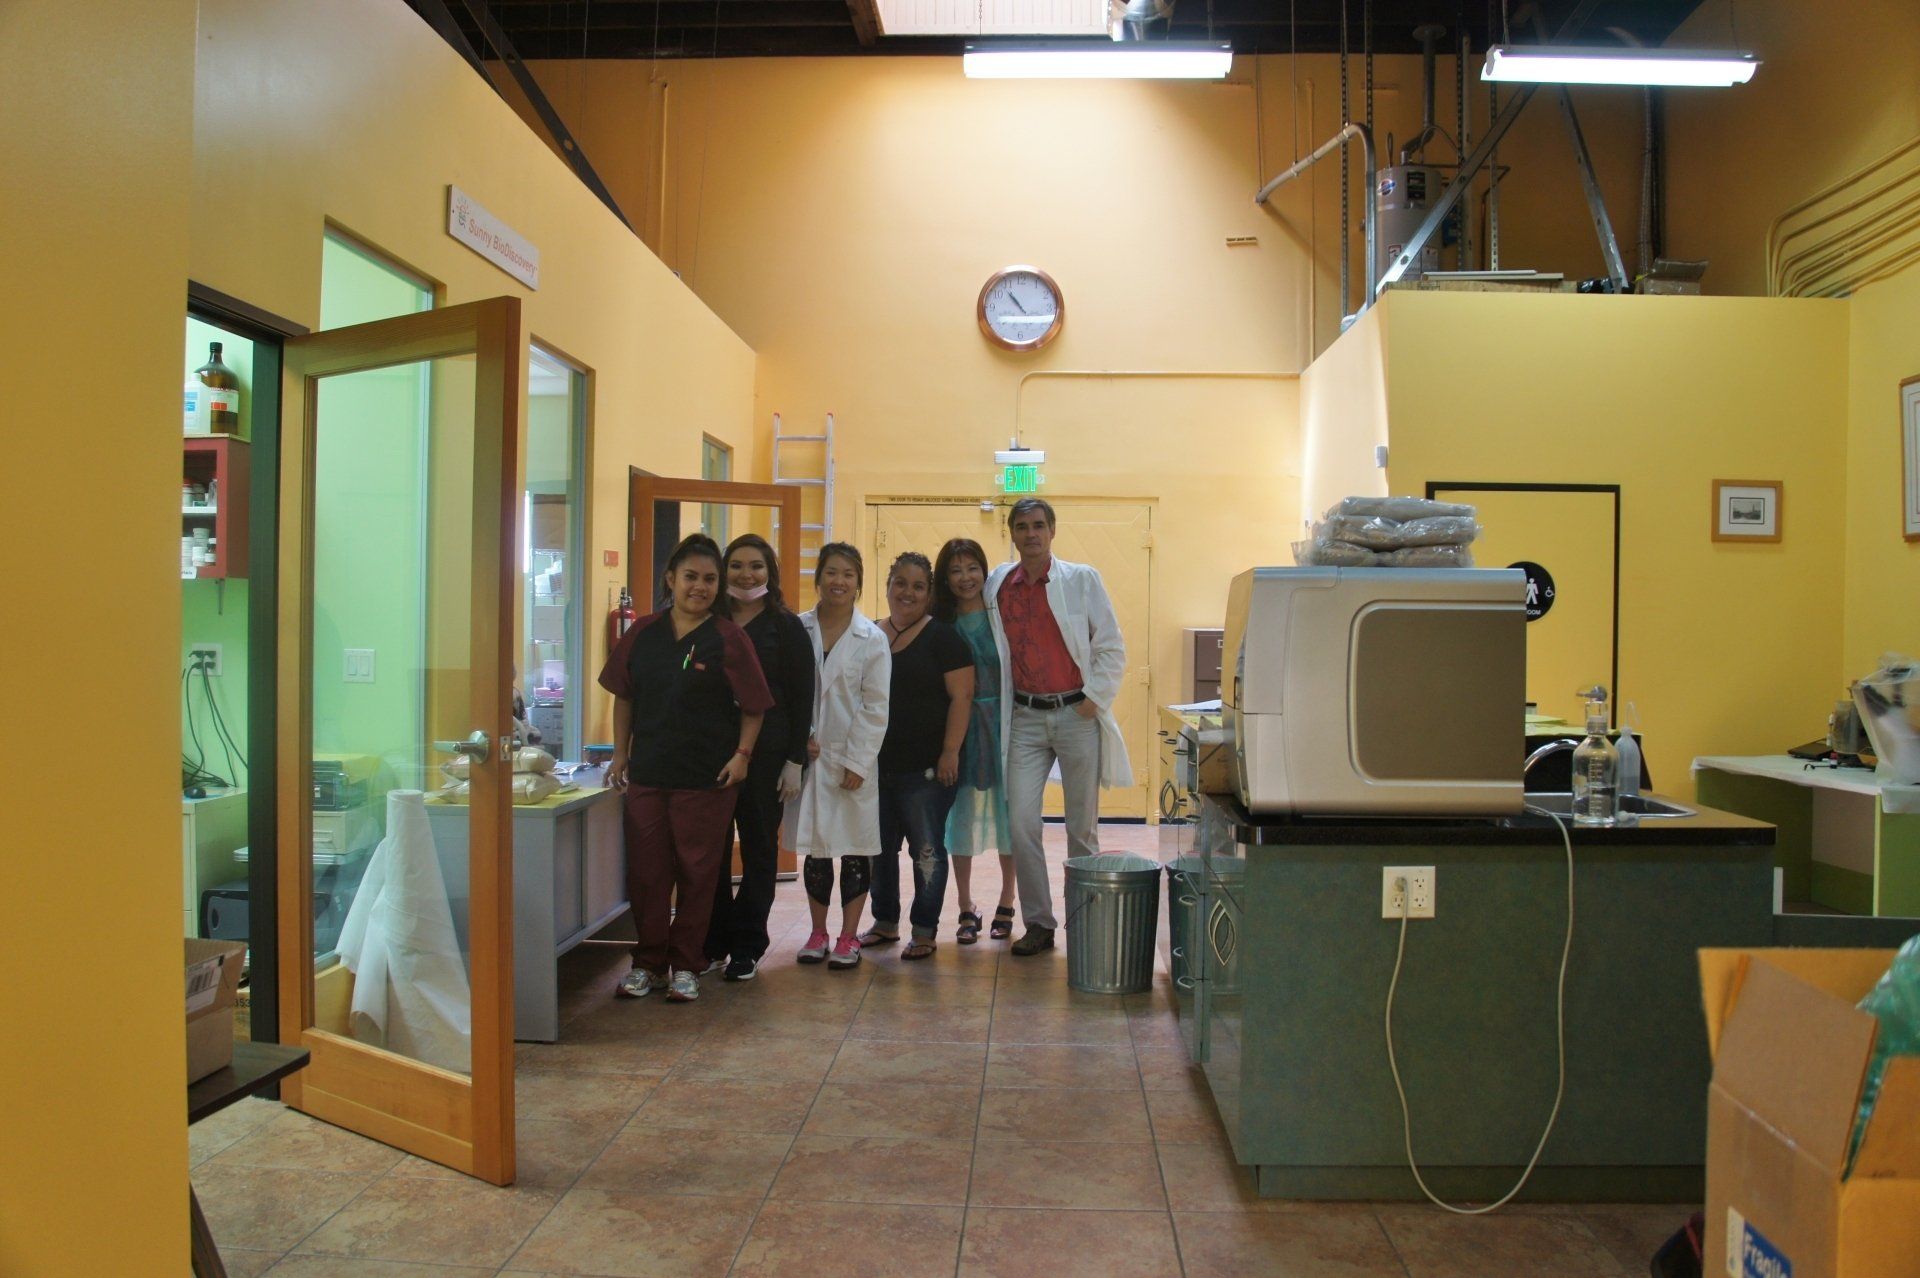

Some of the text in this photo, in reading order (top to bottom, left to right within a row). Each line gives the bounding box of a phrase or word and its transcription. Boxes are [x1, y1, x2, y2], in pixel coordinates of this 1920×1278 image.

[468, 218, 536, 279] Sunny BioDiscovery
[1003, 279, 1012, 289] 11
[1017, 275, 1026, 285] 12
[994, 289, 1004, 299] 10
[1043, 290, 1049, 300] 2
[989, 303, 996, 312] 9
[1046, 303, 1053, 313] 3
[1017, 330, 1024, 340] 6
[1004, 465, 1038, 492] EXIT
